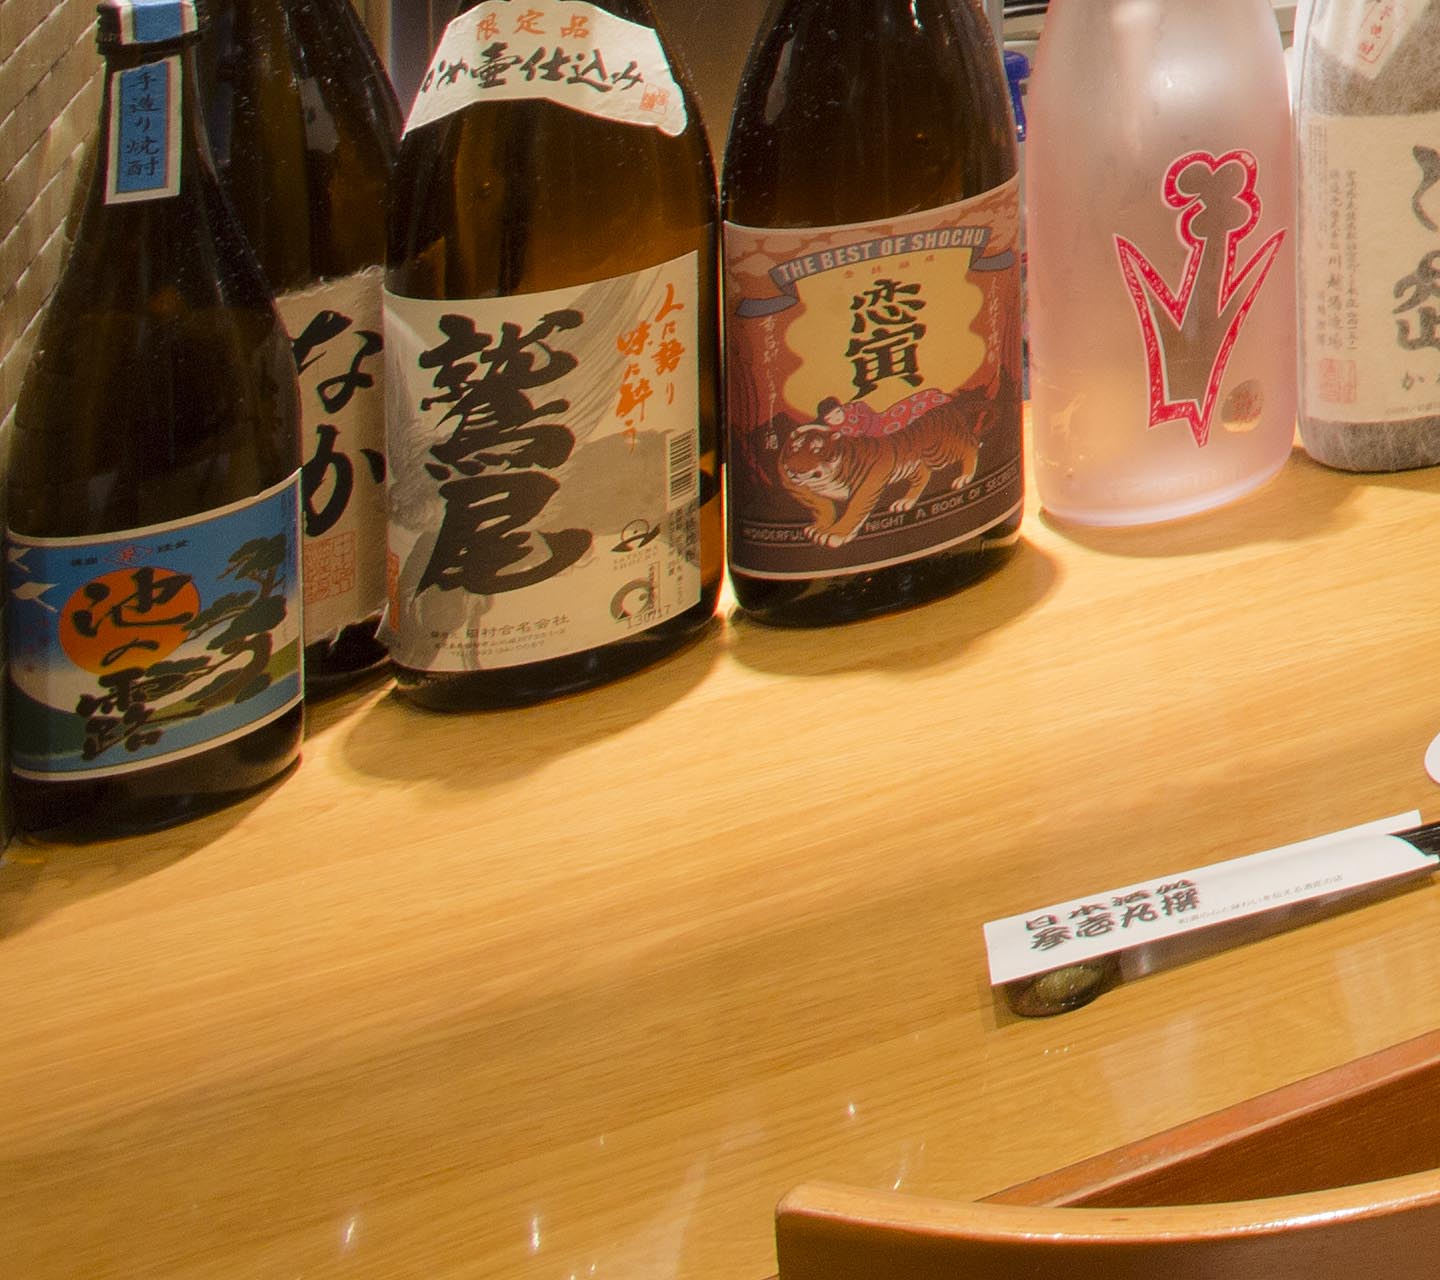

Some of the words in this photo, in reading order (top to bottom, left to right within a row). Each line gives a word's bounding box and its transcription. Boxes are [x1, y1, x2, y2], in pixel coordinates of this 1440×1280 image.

[477, 8, 594, 41] 限定品
[126, 68, 161, 177] 手造り焼酎
[778, 254, 816, 283] THE
[820, 240, 872, 272] BEST
[880, 235, 906, 256] OF
[911, 227, 985, 251] SHOCHU
[845, 277, 927, 402] 恋寅
[865, 513, 905, 533] NIGHT
[931, 496, 965, 515] BOOK
[71, 566, 193, 762] 池の露
[1024, 878, 1199, 933] 日本酒処
